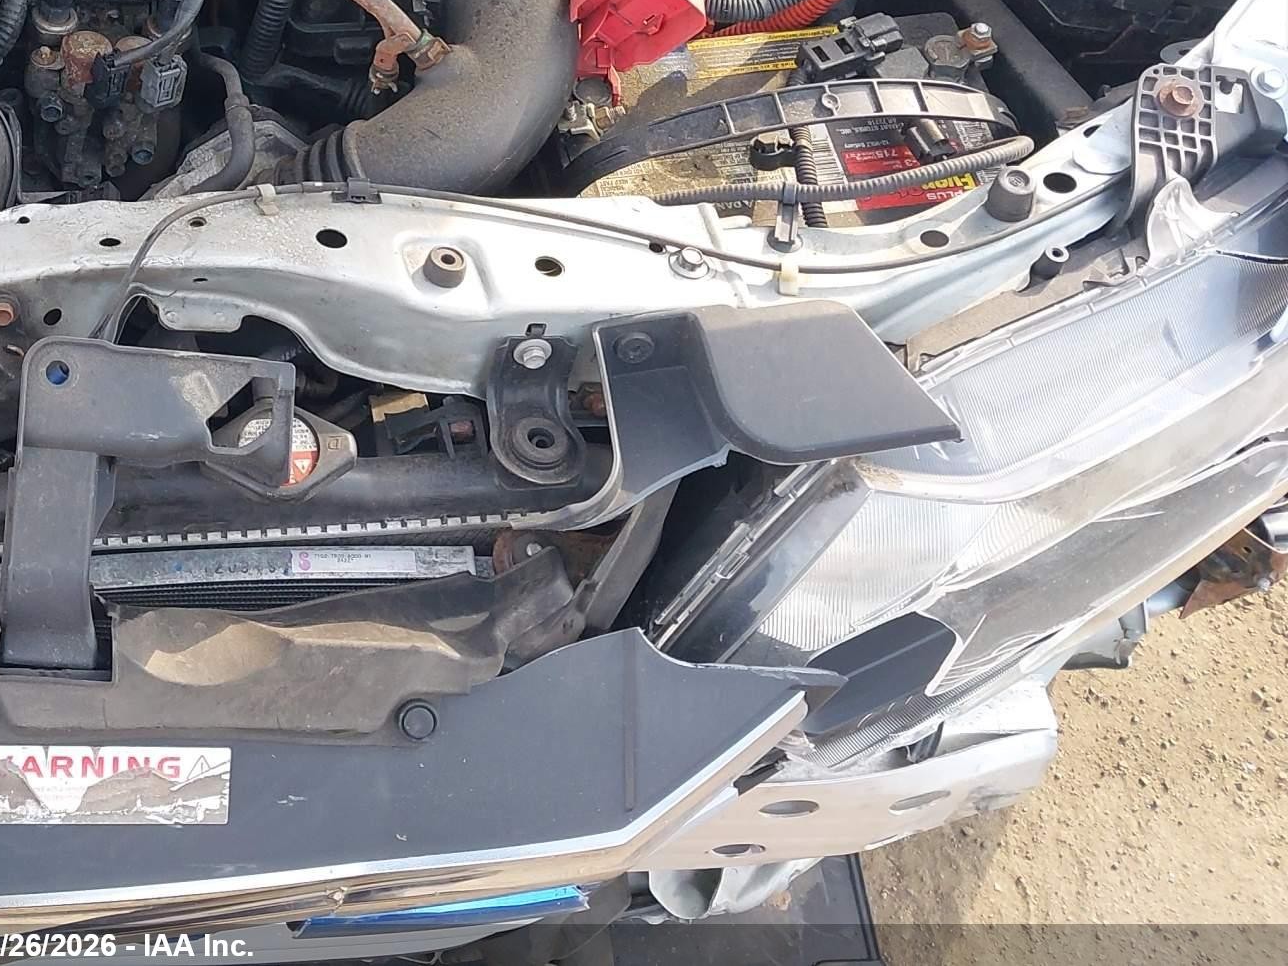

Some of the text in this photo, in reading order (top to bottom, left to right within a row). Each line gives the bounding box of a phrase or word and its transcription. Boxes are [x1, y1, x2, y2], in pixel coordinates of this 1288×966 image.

[875, 149, 898, 159] 715
[926, 189, 964, 201] PLUS
[715, 200, 743, 211] DAN
